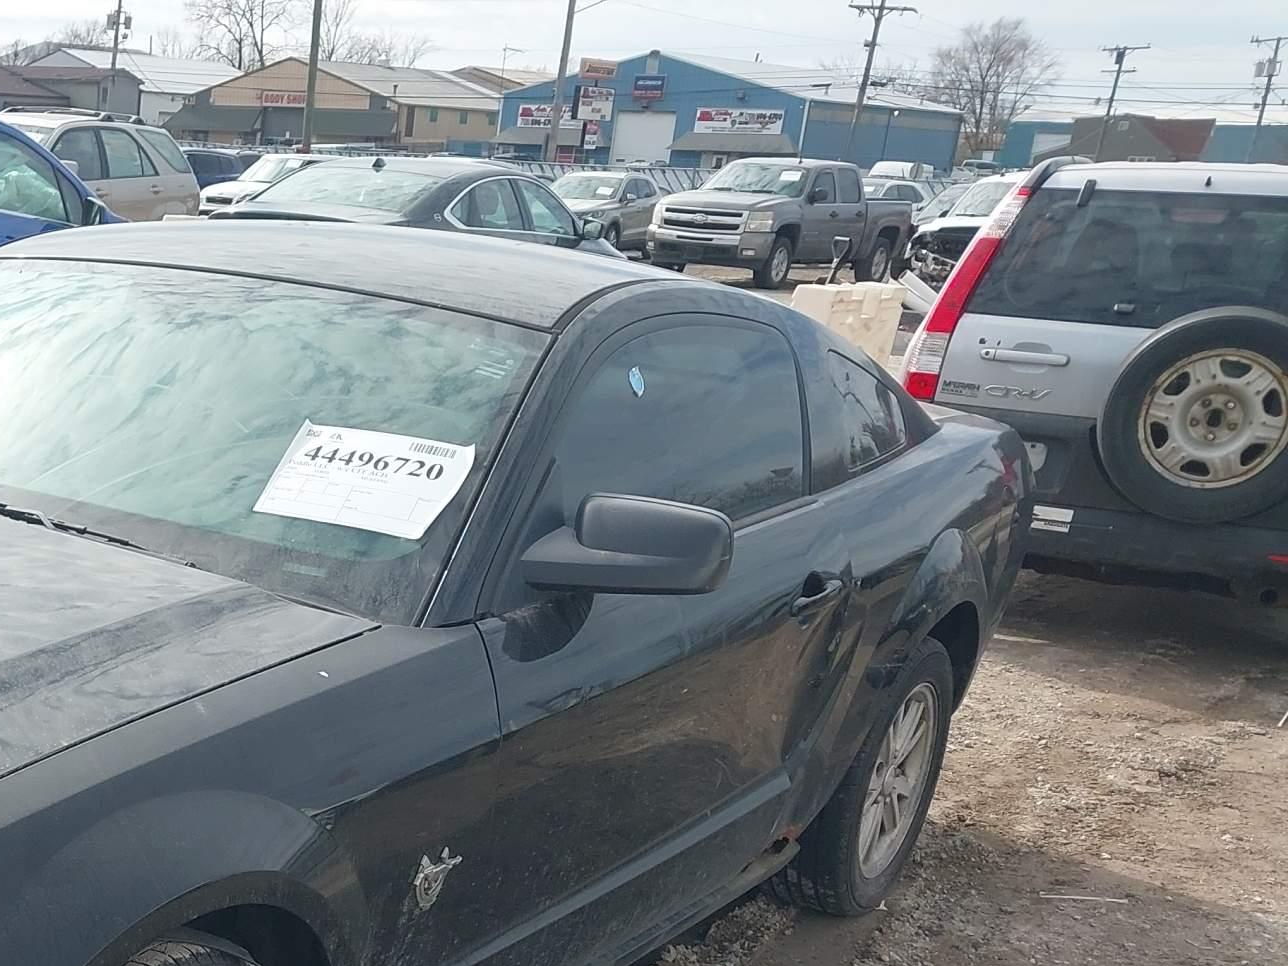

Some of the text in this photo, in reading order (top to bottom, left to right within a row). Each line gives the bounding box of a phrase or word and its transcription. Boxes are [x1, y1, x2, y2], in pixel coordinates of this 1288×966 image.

[264, 94, 285, 104] BODY
[984, 384, 1054, 400] CR-V
[304, 445, 444, 481] 44496720
